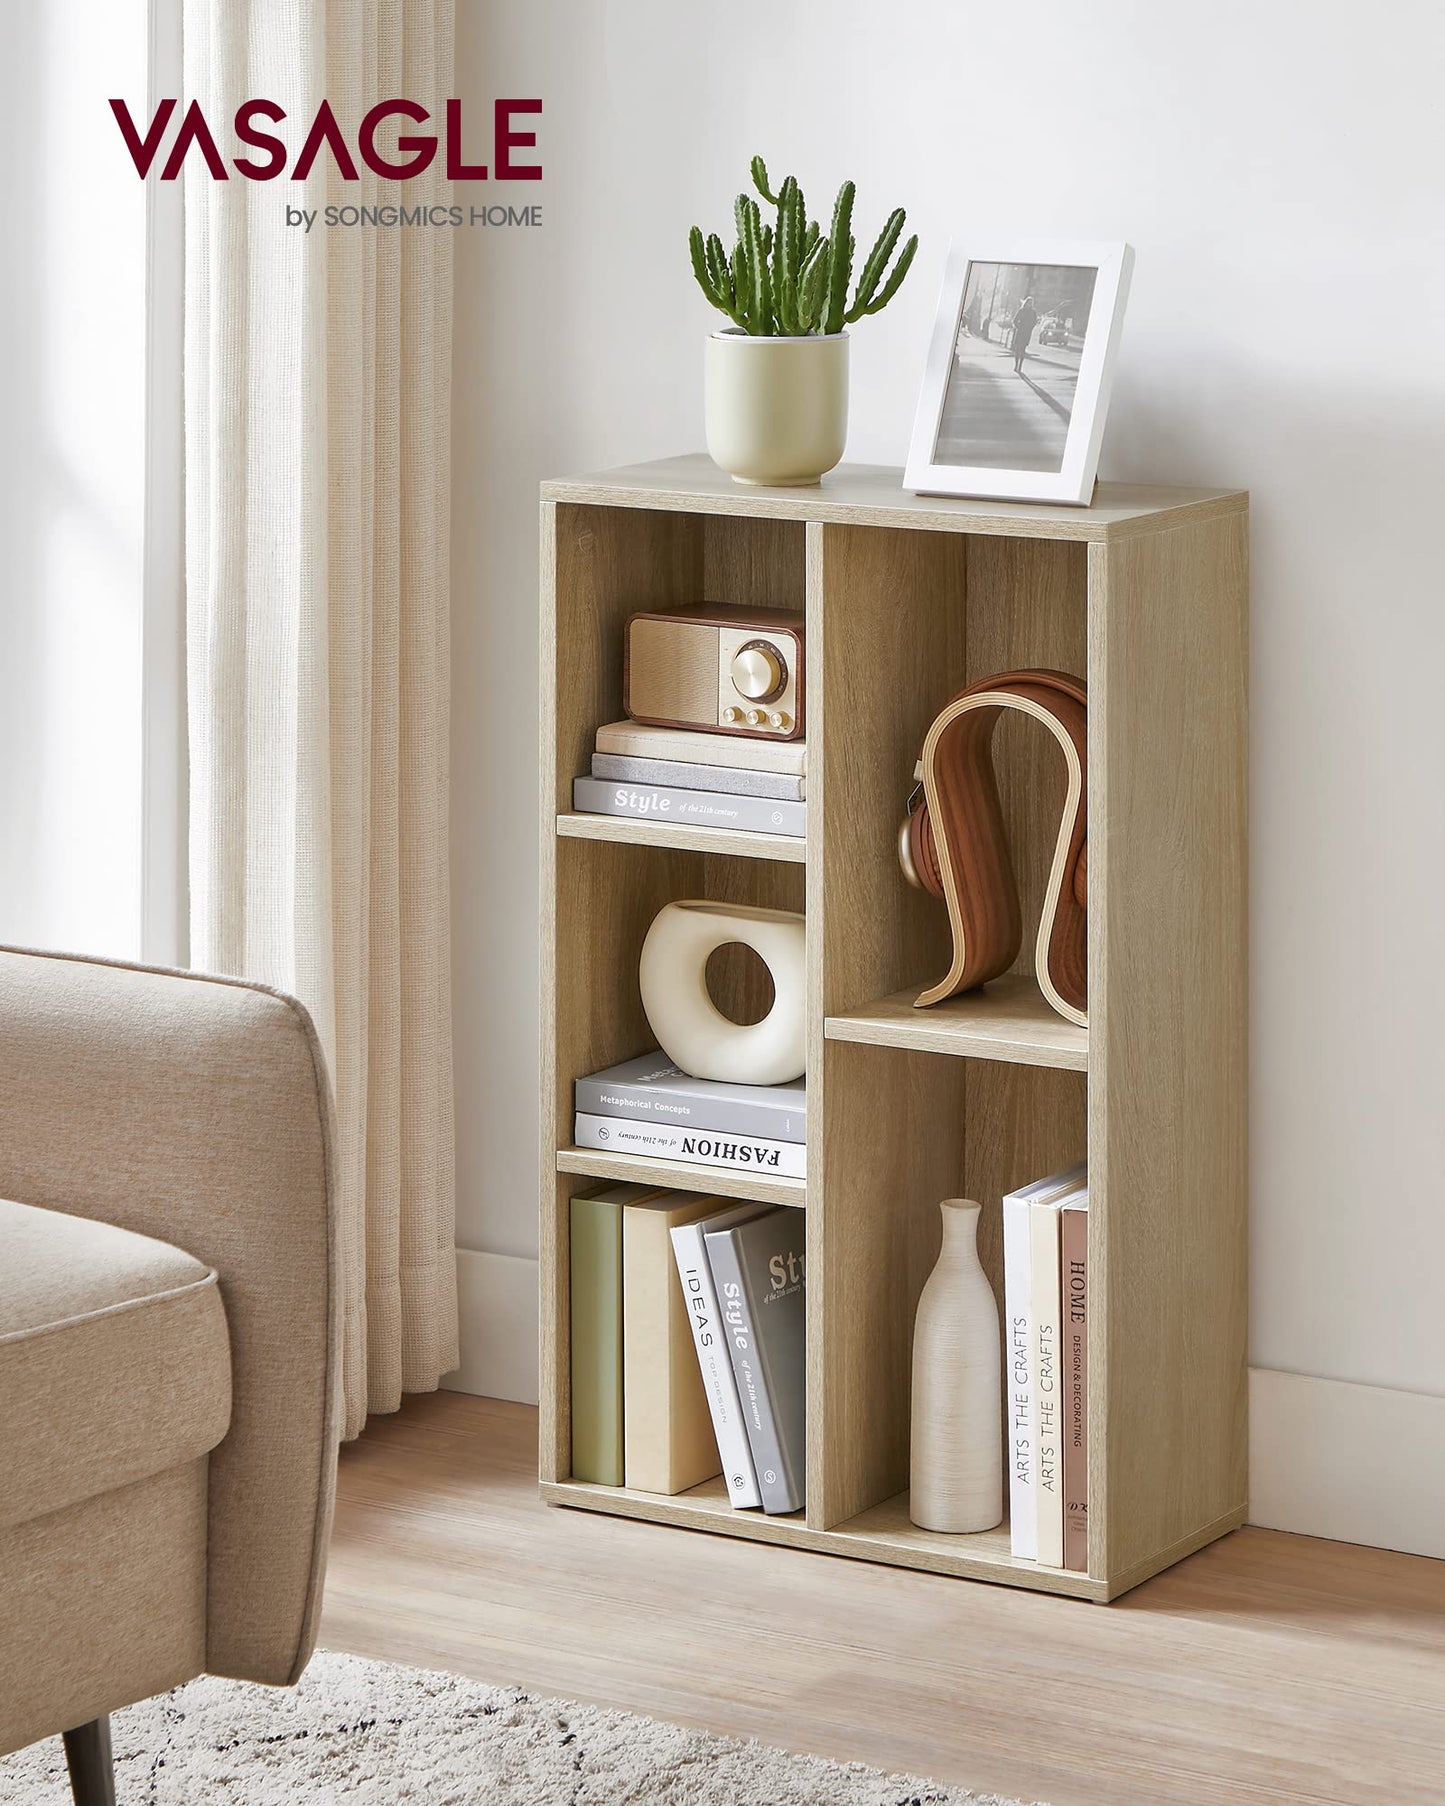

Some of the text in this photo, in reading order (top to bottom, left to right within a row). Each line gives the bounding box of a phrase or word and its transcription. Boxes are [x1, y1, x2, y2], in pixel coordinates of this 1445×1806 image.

[615, 789, 671, 813] Style
[600, 1095, 691, 1115] Metaphorical Concepts
[681, 1137, 781, 1166] FASHION
[686, 1269, 727, 1424] IDEAS TOP DESIGN
[723, 1282, 749, 1350] Style
[1070, 1261, 1086, 1448] HOME DESIGN & DECORATING
[1014, 1317, 1030, 1484] ARTS THE CRAFTS
[1040, 1325, 1055, 1492] ARTS THE CRAFTS
